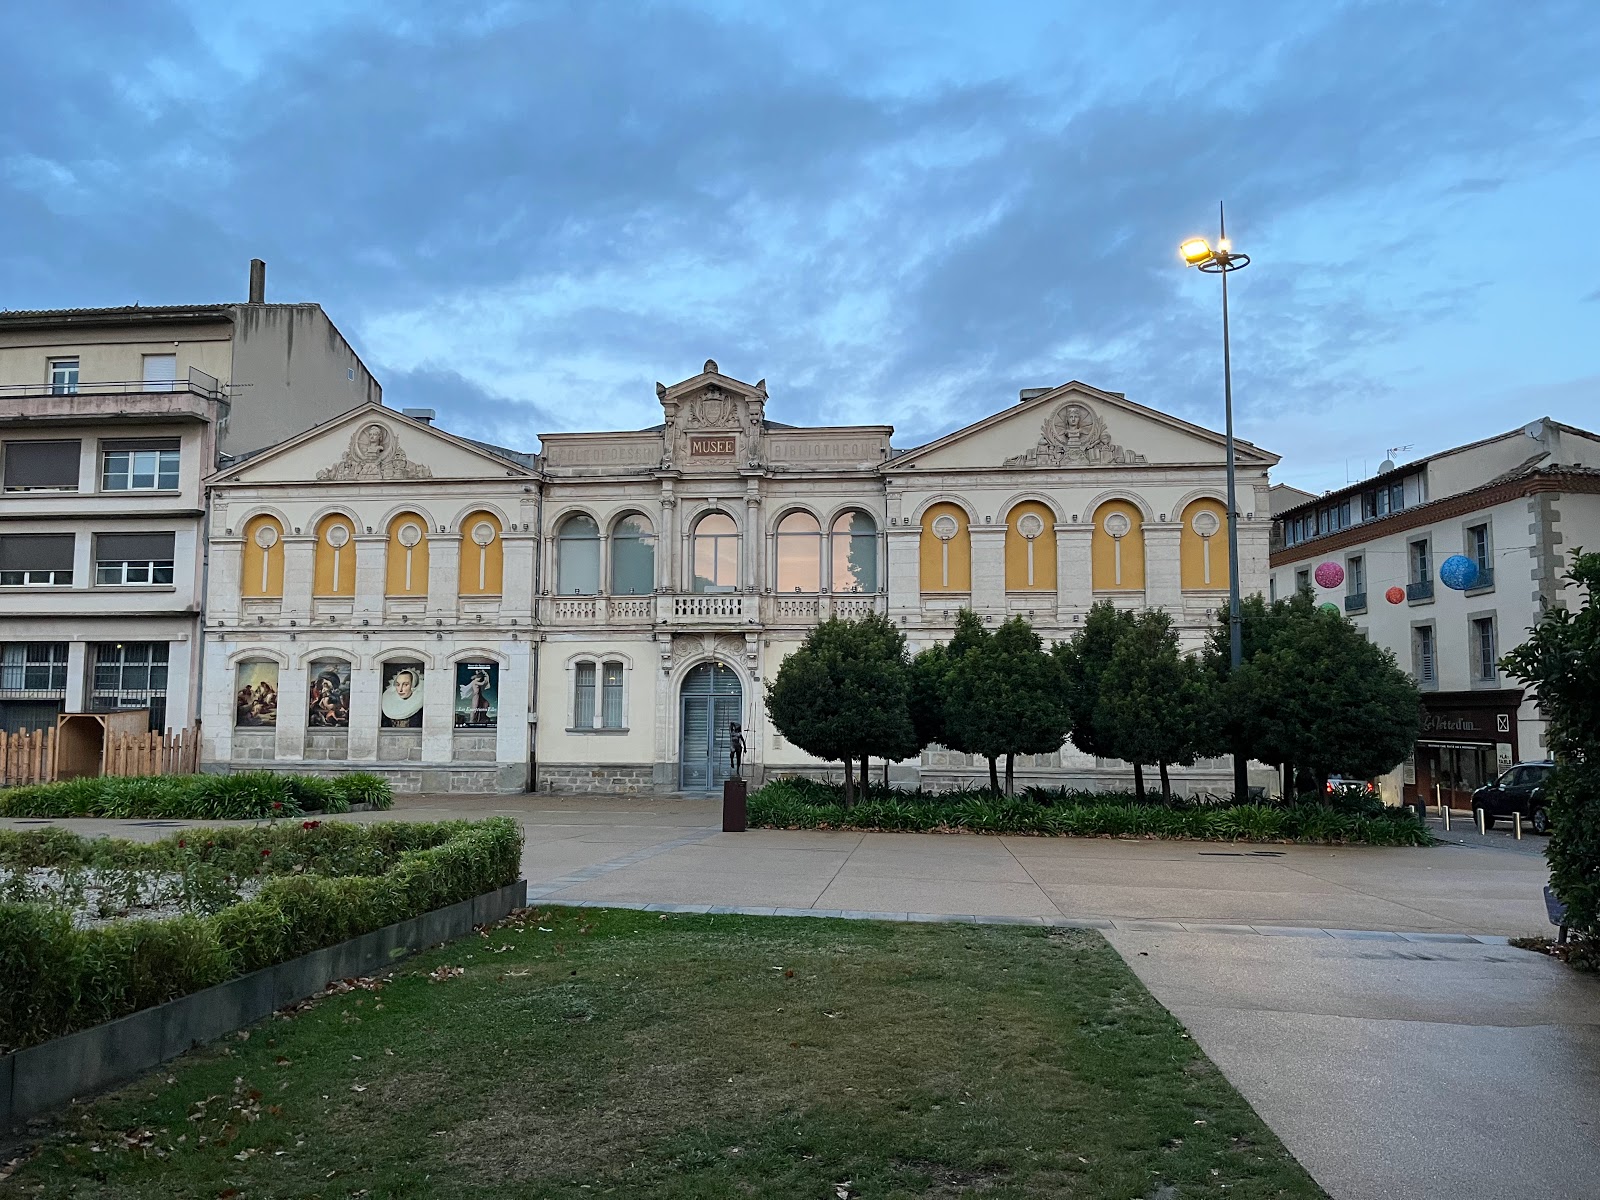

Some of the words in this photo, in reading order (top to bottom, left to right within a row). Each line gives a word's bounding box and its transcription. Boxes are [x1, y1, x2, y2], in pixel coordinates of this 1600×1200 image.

[692, 440, 735, 454] MUSEE
[775, 443, 877, 457] BIBLIOTHEQUE
[551, 448, 590, 462] ECOLE
[593, 448, 608, 461] DE
[611, 447, 655, 460] DESSIN
